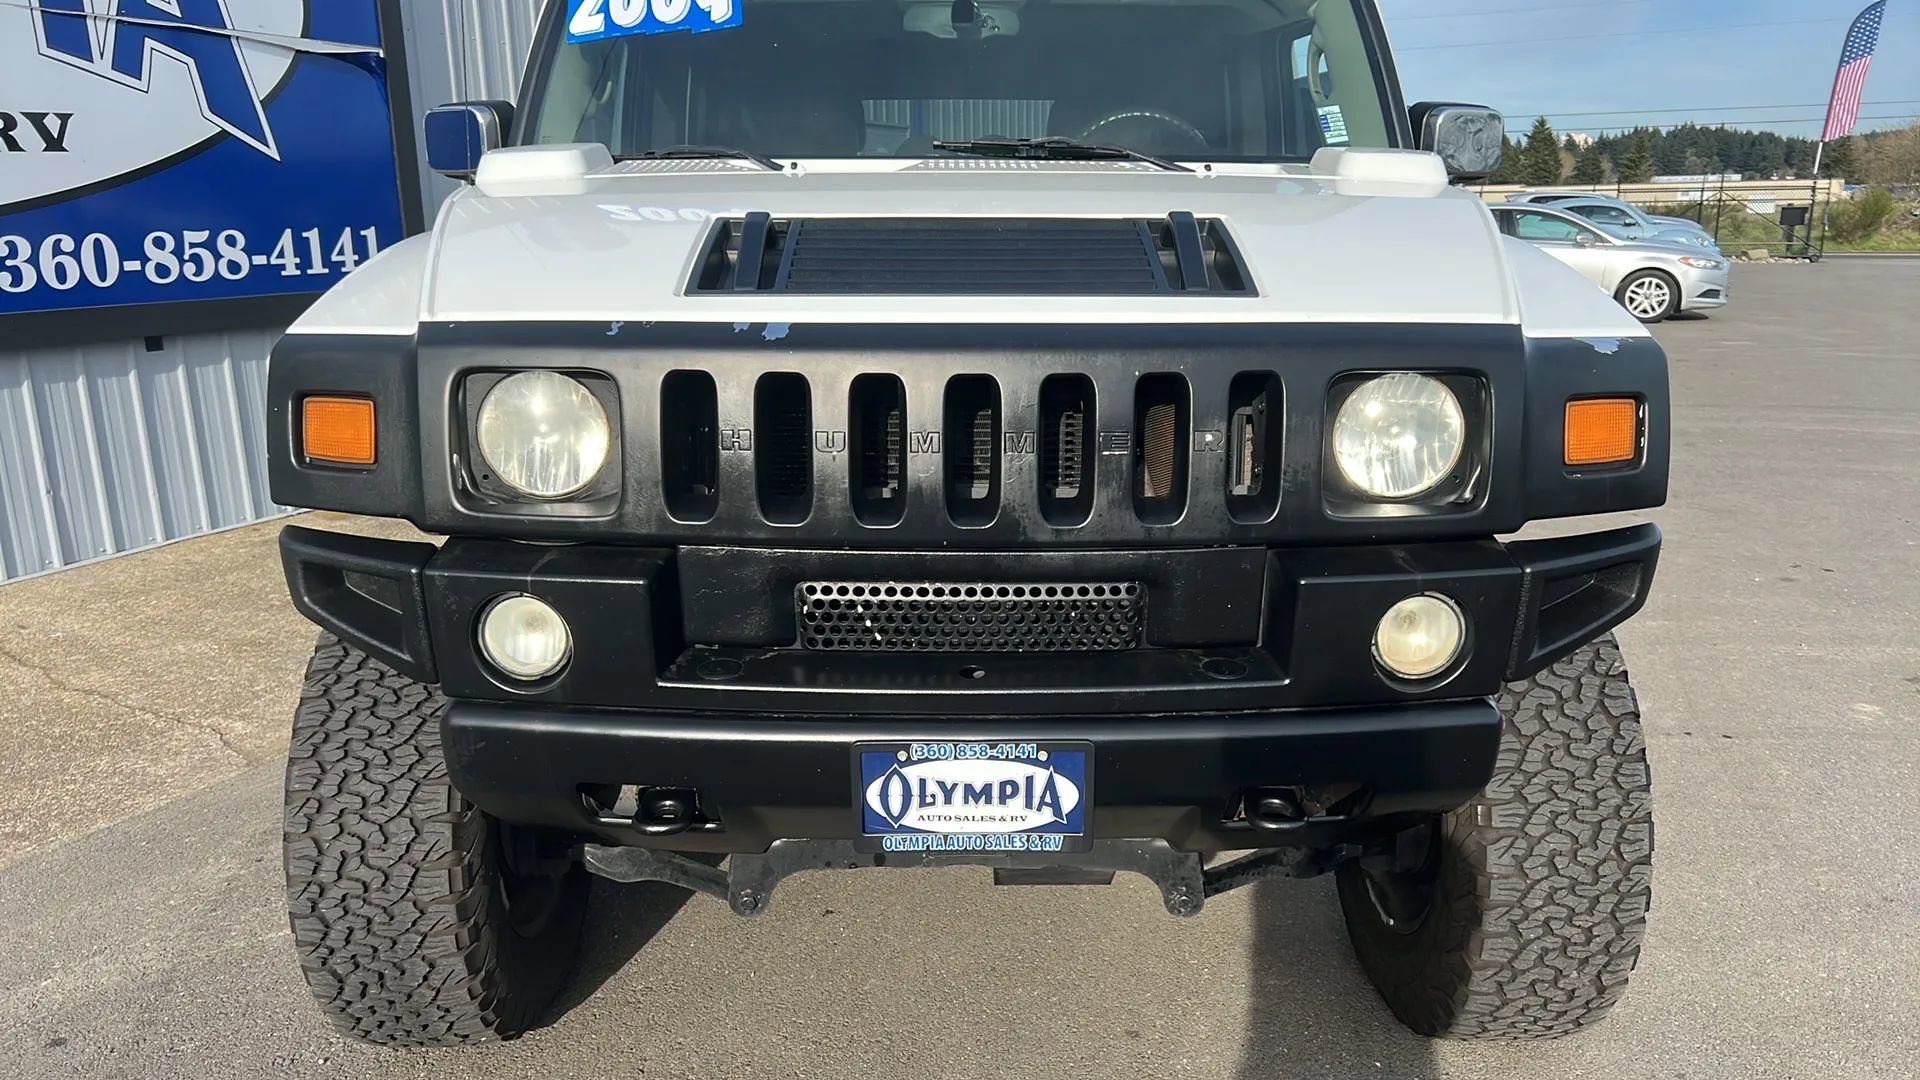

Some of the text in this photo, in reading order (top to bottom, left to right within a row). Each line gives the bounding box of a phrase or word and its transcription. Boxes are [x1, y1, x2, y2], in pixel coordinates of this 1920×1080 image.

[0, 112, 74, 152] RV
[0, 226, 379, 293] 360-858-4141
[720, 428, 1224, 455] HUMMER
[910, 744, 1037, 761] (360) 858-4141
[879, 763, 1068, 829] OLYMPIA
[917, 814, 1028, 823] AUTO SALES & RV
[882, 835, 1064, 851] OLYMPIA AUTO SALES & RV
